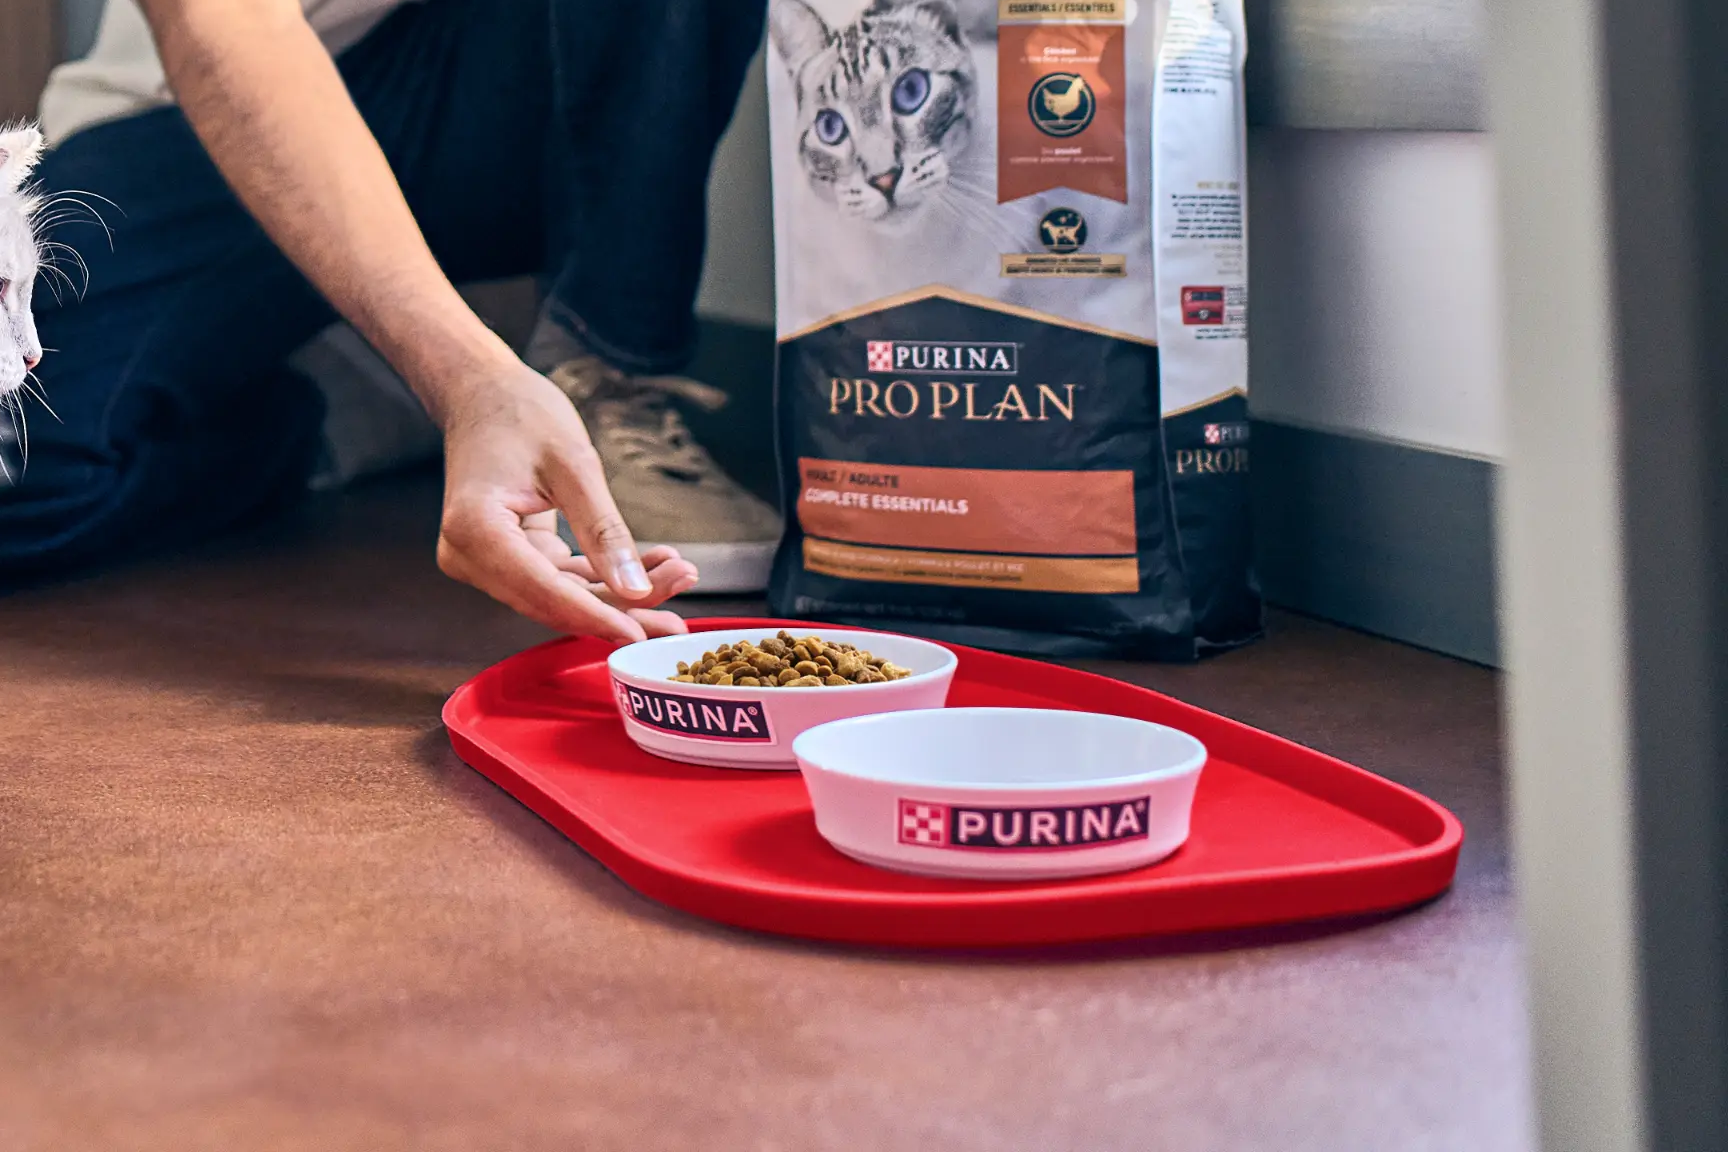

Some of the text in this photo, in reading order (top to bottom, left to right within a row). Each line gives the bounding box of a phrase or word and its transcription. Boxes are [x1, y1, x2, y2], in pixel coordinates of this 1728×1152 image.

[896, 346, 1010, 370] PURINA
[829, 378, 1076, 421] PRO PLAN
[872, 494, 969, 515] ESSENTIALS
